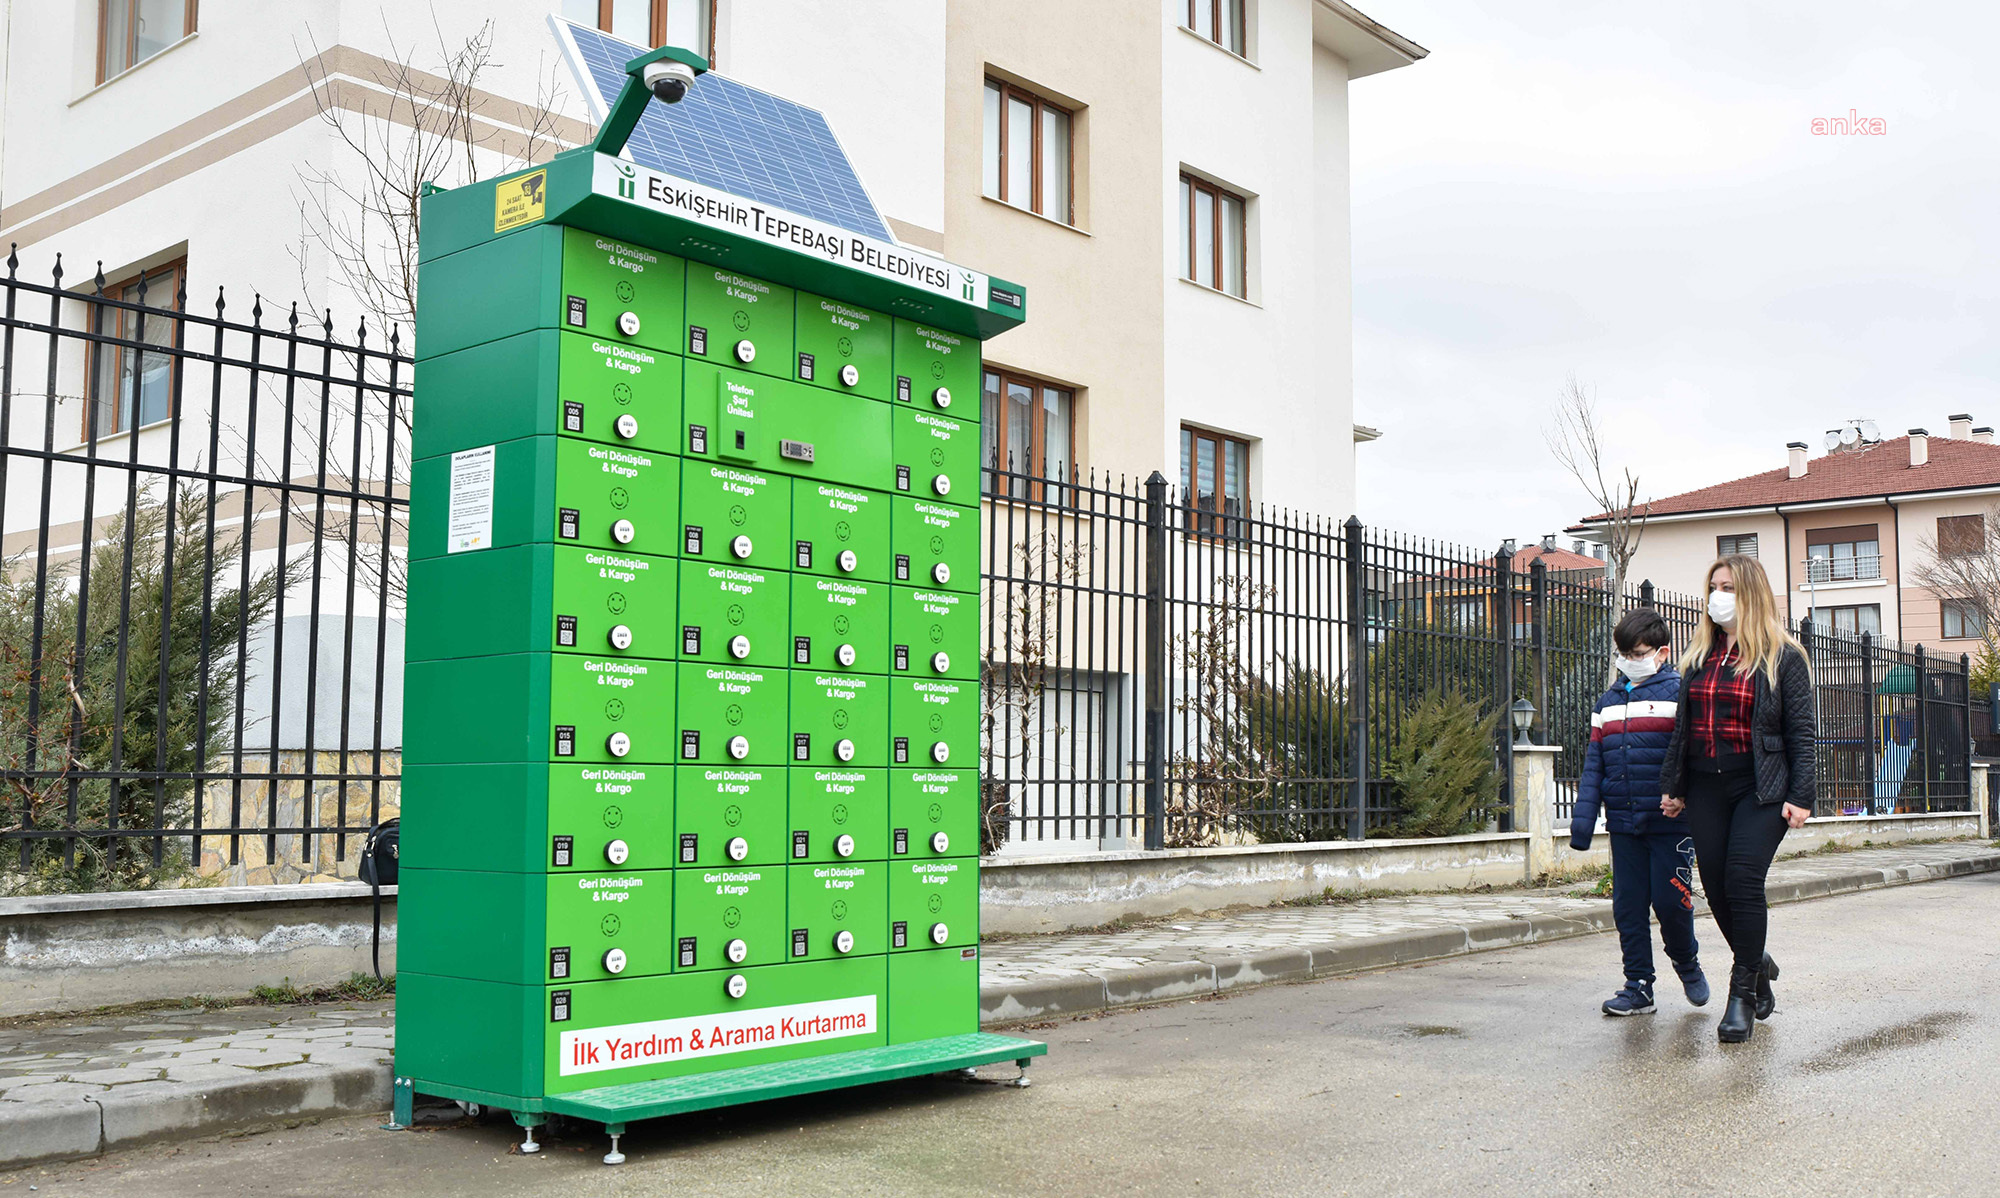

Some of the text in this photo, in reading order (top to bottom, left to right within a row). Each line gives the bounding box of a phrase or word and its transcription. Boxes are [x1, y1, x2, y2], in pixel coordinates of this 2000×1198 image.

[596, 239, 657, 263] Geri Dönüşüm
[609, 255, 643, 273] & Kargo
[715, 272, 769, 294] Geri Dönüşüm
[726, 286, 758, 303] & Kargo
[571, 303, 582, 311] 001
[821, 301, 835, 312] Geri
[831, 315, 859, 330] & Kargo
[693, 332, 703, 340] 002
[916, 327, 929, 337] Geri
[592, 342, 654, 364] Geri Dönüşüm
[926, 340, 951, 354] & Kargo
[606, 358, 641, 374] & Kargo
[726, 381, 754, 396] Telefon
[732, 394, 749, 408] Şarj
[568, 407, 579, 416] 005
[727, 404, 754, 419] Ünitesi
[915, 414, 960, 431] Geri Dönüşüm
[931, 428, 950, 440] Kargo
[589, 447, 651, 466] Geri Dönüşüm
[602, 462, 638, 478] & Kargo
[711, 467, 766, 485] Geri Dönüşüm
[723, 481, 754, 496] & Kargo
[818, 486, 868, 502] Geri Dönüşüm
[829, 499, 858, 513] & Kargo
[914, 503, 959, 518] Geri Dönüşüm
[924, 515, 950, 528] & Kargo
[586, 553, 649, 570] Geri Dönüşüm
[599, 568, 635, 582] & Kargo
[708, 568, 764, 583] Geri Dönüşüm
[720, 581, 752, 595] & Kargo
[817, 581, 867, 595] Geri Dönüşüm
[827, 593, 856, 606] & Kargo
[914, 592, 959, 605] Geri Dönüşüm
[923, 604, 949, 615] & Kargo
[584, 661, 647, 676] Geri Dönüşüm
[597, 675, 634, 688] & Kargo
[706, 669, 763, 683] Geri Dönüşüm
[816, 676, 866, 689] Geri Dönüşüm
[719, 682, 751, 695] & Kargo
[826, 688, 855, 700] & Kargo
[913, 682, 959, 694] Geri Dönüşüm
[923, 693, 949, 705] & Kargo
[581, 769, 645, 782] Geri Dönüşüm
[705, 771, 762, 782] Geri Dönüşüm
[815, 772, 865, 783] Geri Dönüşüm
[912, 773, 958, 783] Geri Dönüşüm
[595, 782, 632, 795] & Kargo
[717, 783, 749, 795] & Kargo
[826, 783, 855, 795] & Kargo
[922, 784, 948, 794] & Kargo
[814, 867, 865, 878] Geri Dönüşüm
[912, 864, 958, 873] Geri Dönüşüm
[579, 877, 643, 889] Geri Dönüşüm
[704, 872, 761, 883] Geri Dönüşüm
[922, 875, 948, 885] & Kargo
[716, 885, 749, 896] & Kargo
[825, 879, 854, 890] & Kargo
[592, 891, 629, 902] & Kargo
[573, 1012, 866, 1066] İlk Yardım & Arama Kurtarma
